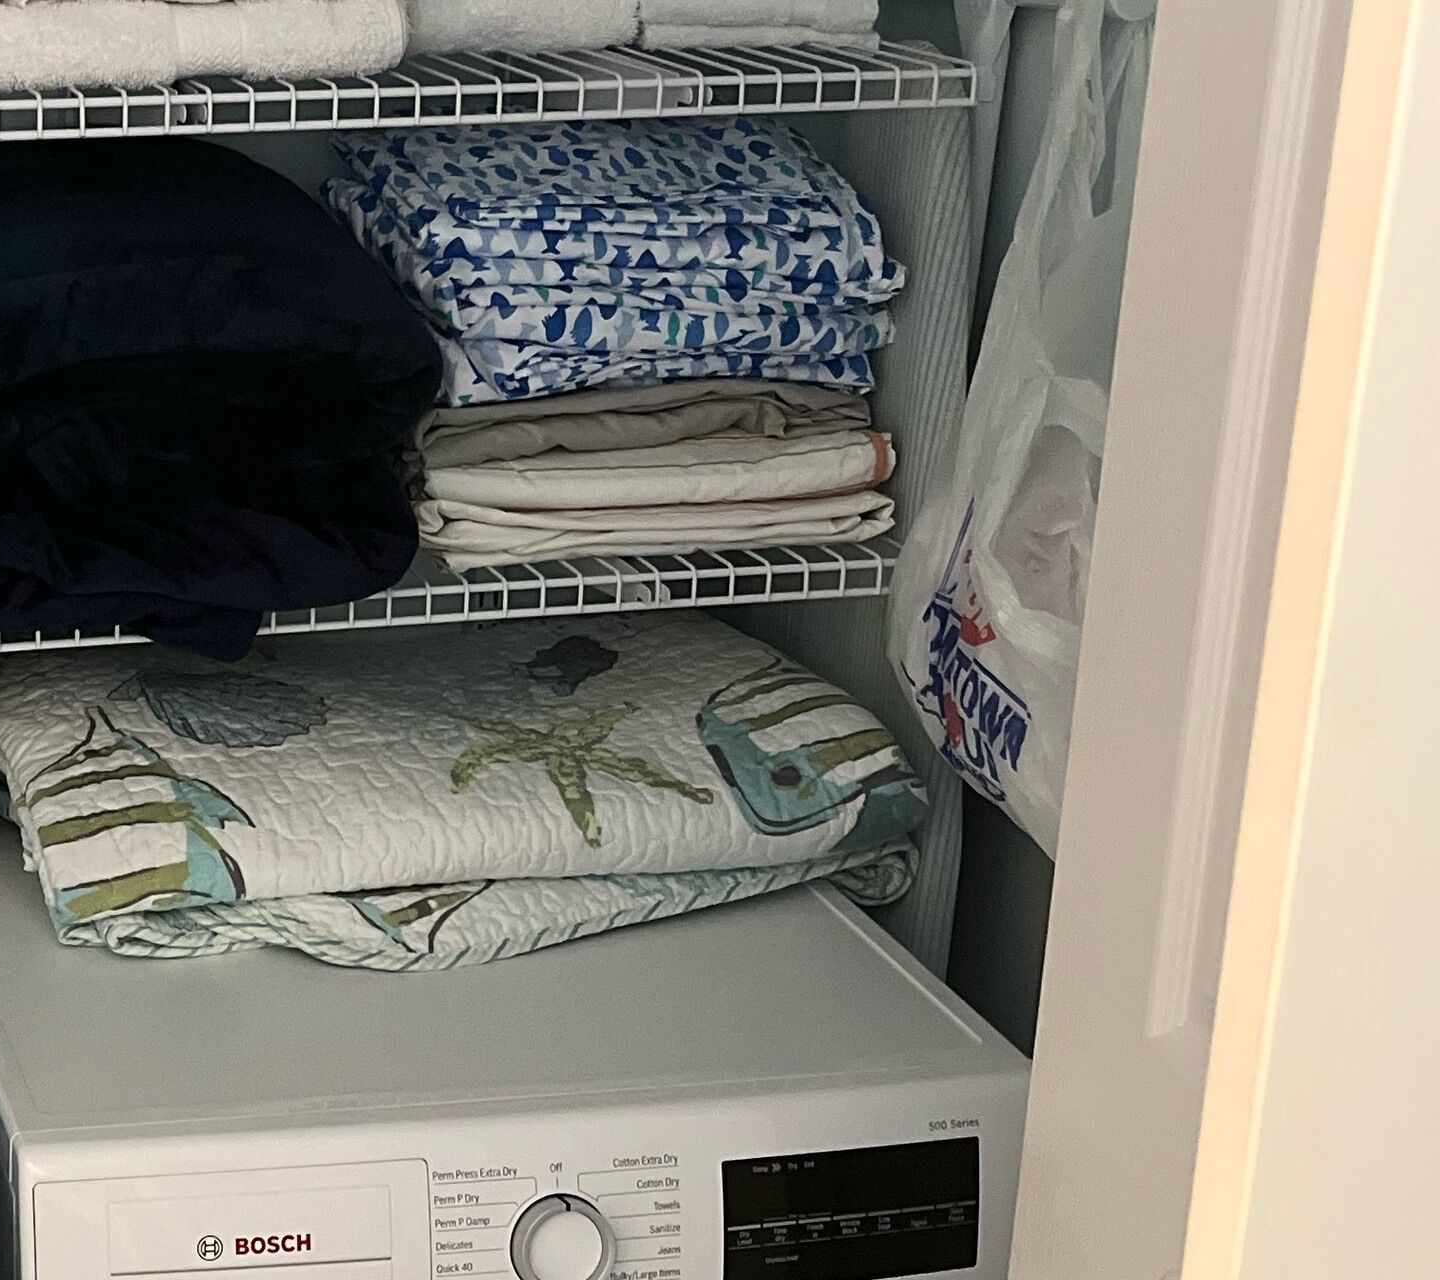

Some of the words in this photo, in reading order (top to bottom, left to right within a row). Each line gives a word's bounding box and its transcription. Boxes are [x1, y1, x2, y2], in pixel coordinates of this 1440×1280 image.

[929, 1121, 948, 1131] 500
[951, 1119, 980, 1129] Series
[613, 1157, 640, 1168] Cotton
[642, 1156, 662, 1166] Extra
[664, 1154, 678, 1166] Dry
[550, 1162, 563, 1173] Off
[432, 1170, 454, 1181] Perm
[456, 1169, 478, 1179] Press
[480, 1168, 501, 1178] Extra
[503, 1166, 518, 1178] Dry
[637, 1179, 663, 1190] Cotton
[665, 1177, 680, 1189] Dry
[434, 1195, 456, 1205] Perm
[457, 1194, 463, 1204] P
[465, 1194, 480, 1205] Dry
[654, 1200, 681, 1211] Towels
[435, 1219, 456, 1229] Perm
[458, 1218, 464, 1227] P
[466, 1217, 490, 1228] Damp
[650, 1224, 681, 1234] Sanitize
[235, 1233, 311, 1255] BOSCH
[436, 1240, 473, 1251] Delicates
[658, 1246, 681, 1255] Jeans
[436, 1264, 459, 1274] Quick
[461, 1262, 473, 1272] 40
[610, 1269, 658, 1280] Bulky/Large
[659, 1269, 681, 1278] Items
